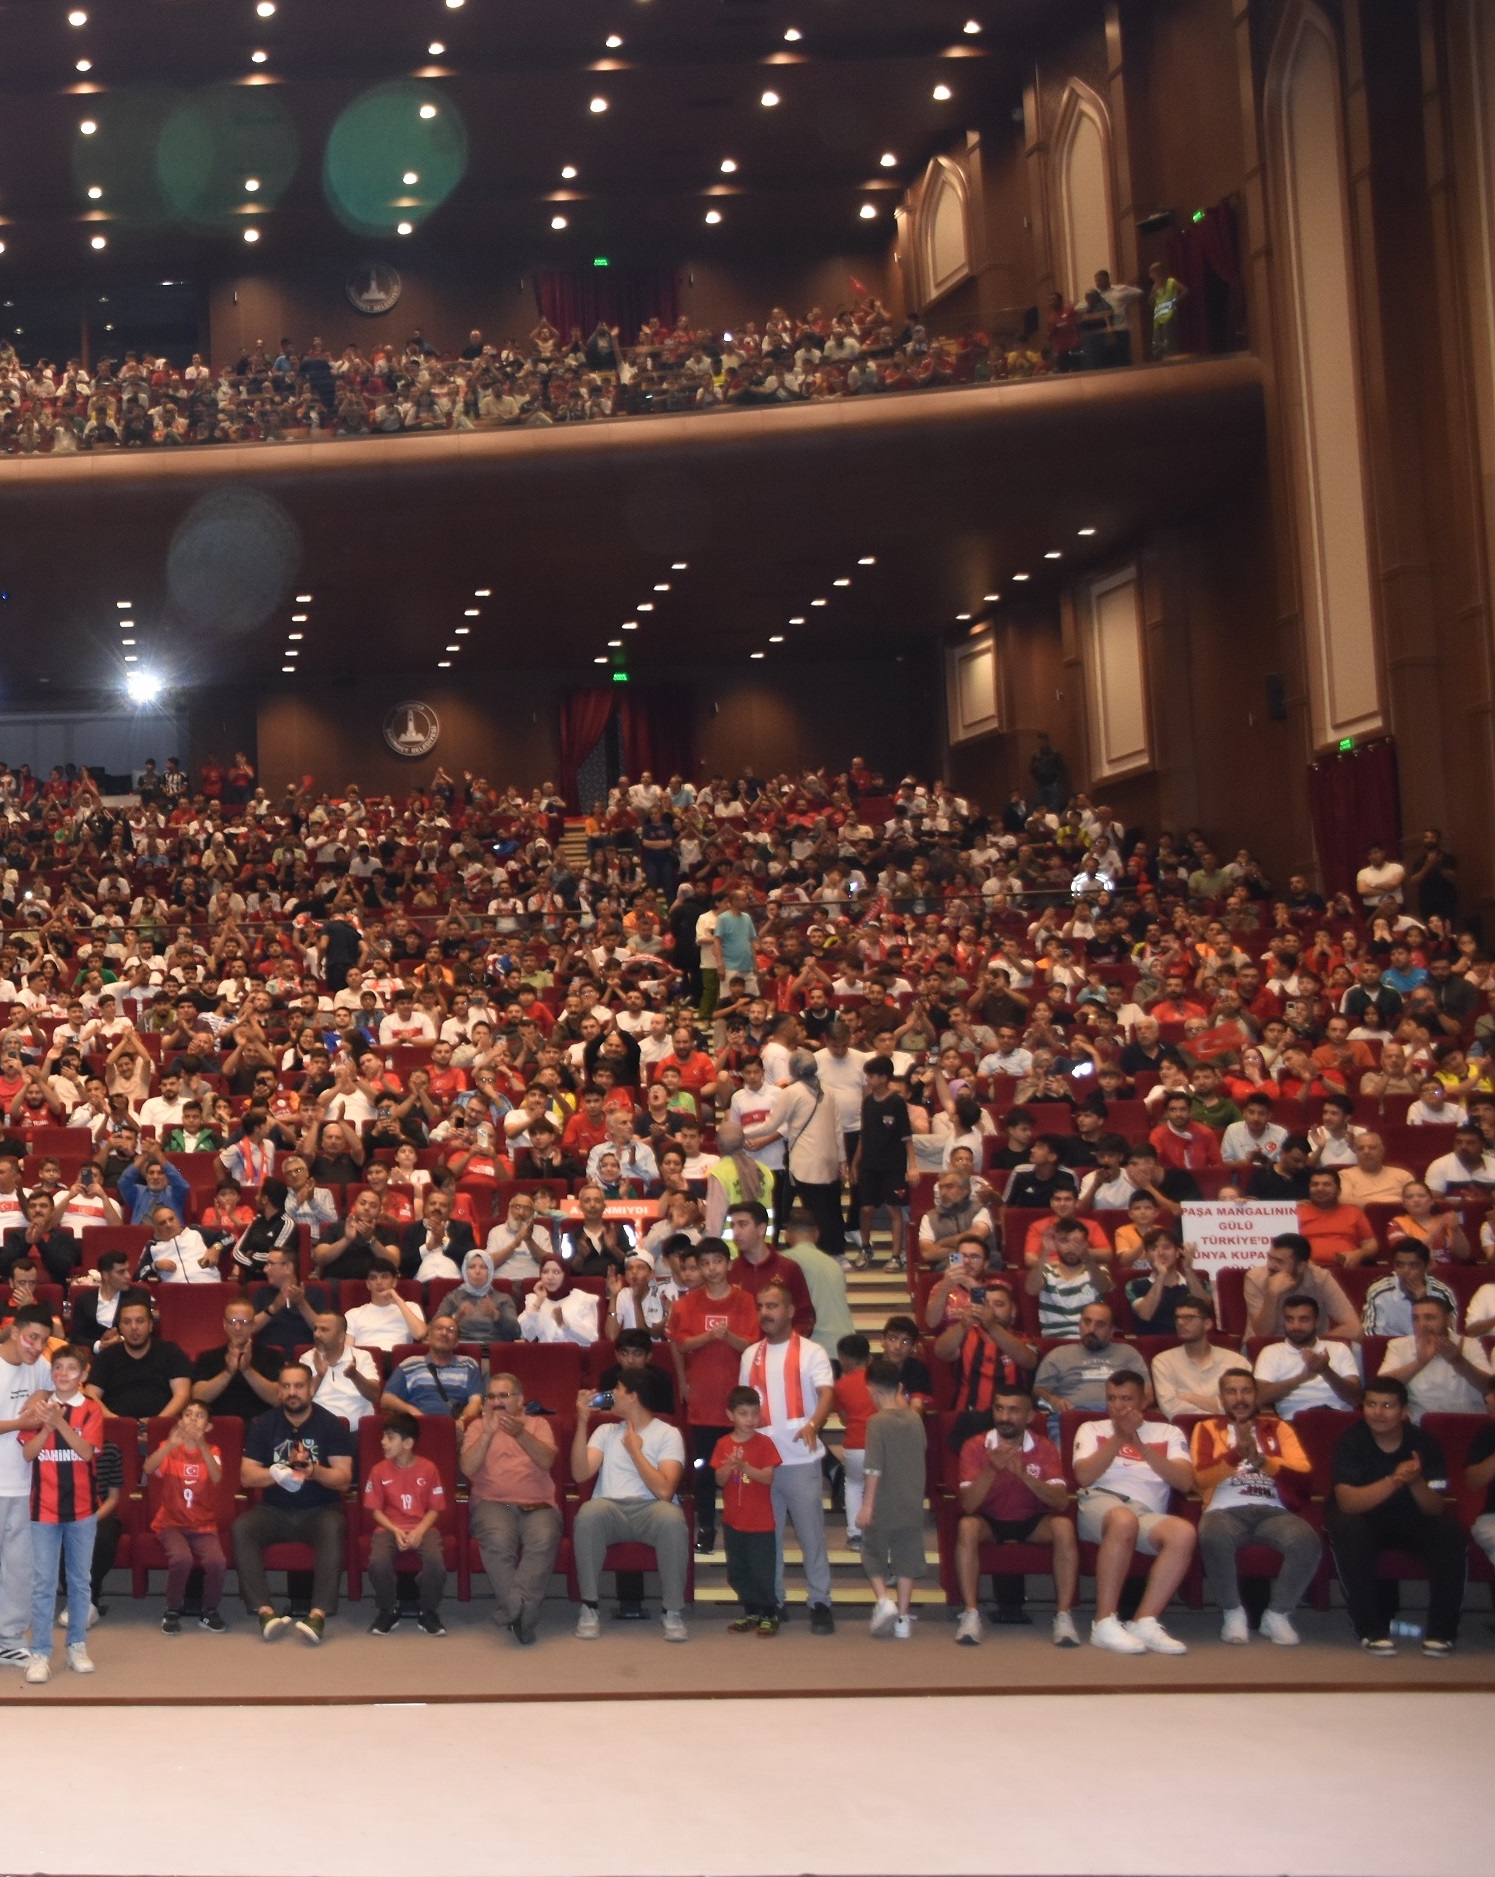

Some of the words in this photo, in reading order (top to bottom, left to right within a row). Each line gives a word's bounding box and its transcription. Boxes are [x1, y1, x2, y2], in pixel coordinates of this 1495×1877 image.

[1216, 1207, 1297, 1216] MANGALININ
[183, 1487, 193, 1508] 9
[400, 1493, 412, 1510] 19
